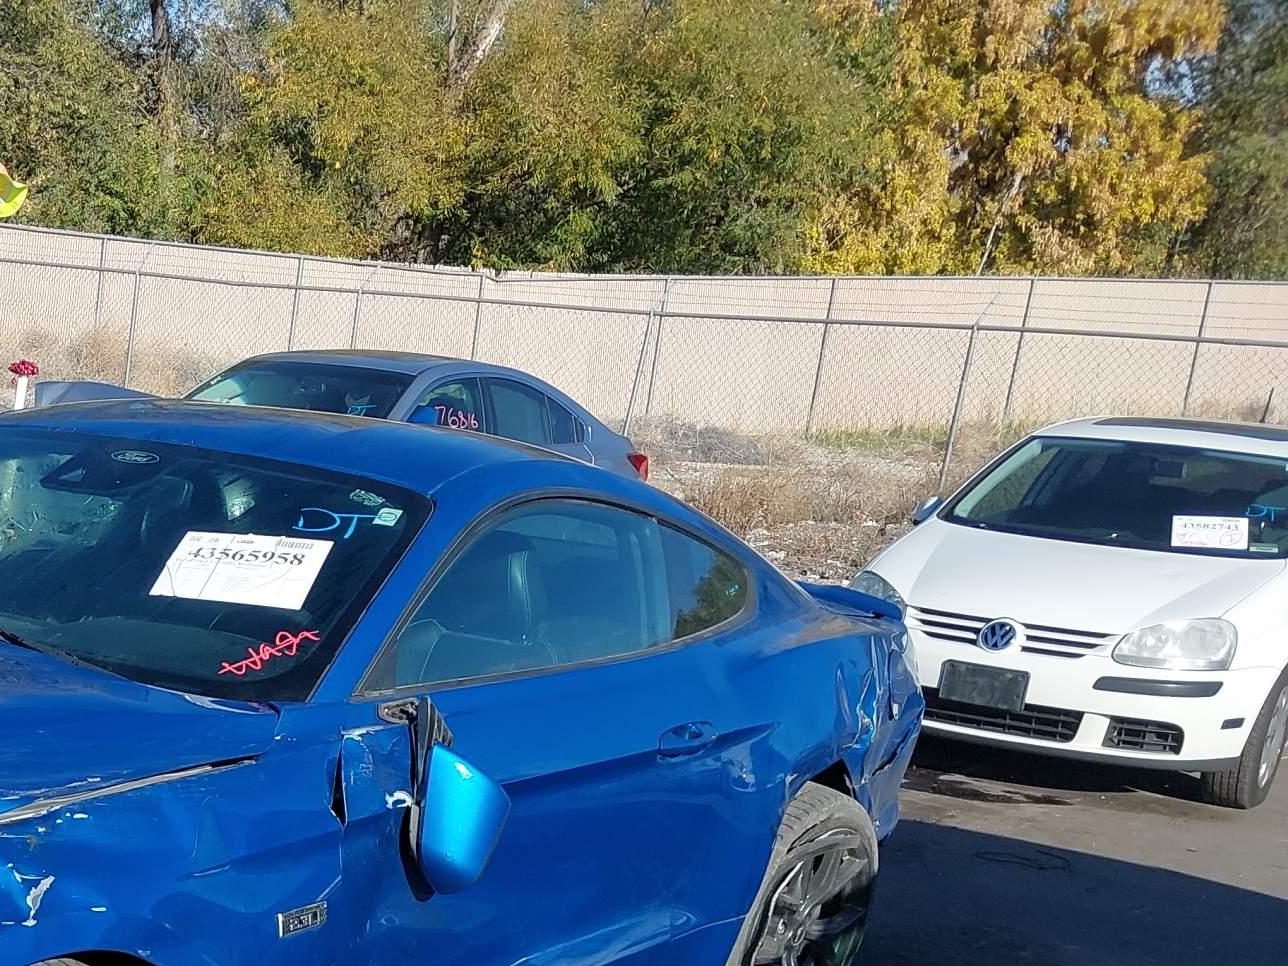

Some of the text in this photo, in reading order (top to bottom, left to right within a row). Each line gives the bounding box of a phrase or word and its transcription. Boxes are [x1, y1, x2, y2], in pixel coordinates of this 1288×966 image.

[435, 406, 479, 429] 76816
[292, 507, 380, 539] DT
[1246, 504, 1287, 523] DT
[188, 546, 306, 566] 43565958
